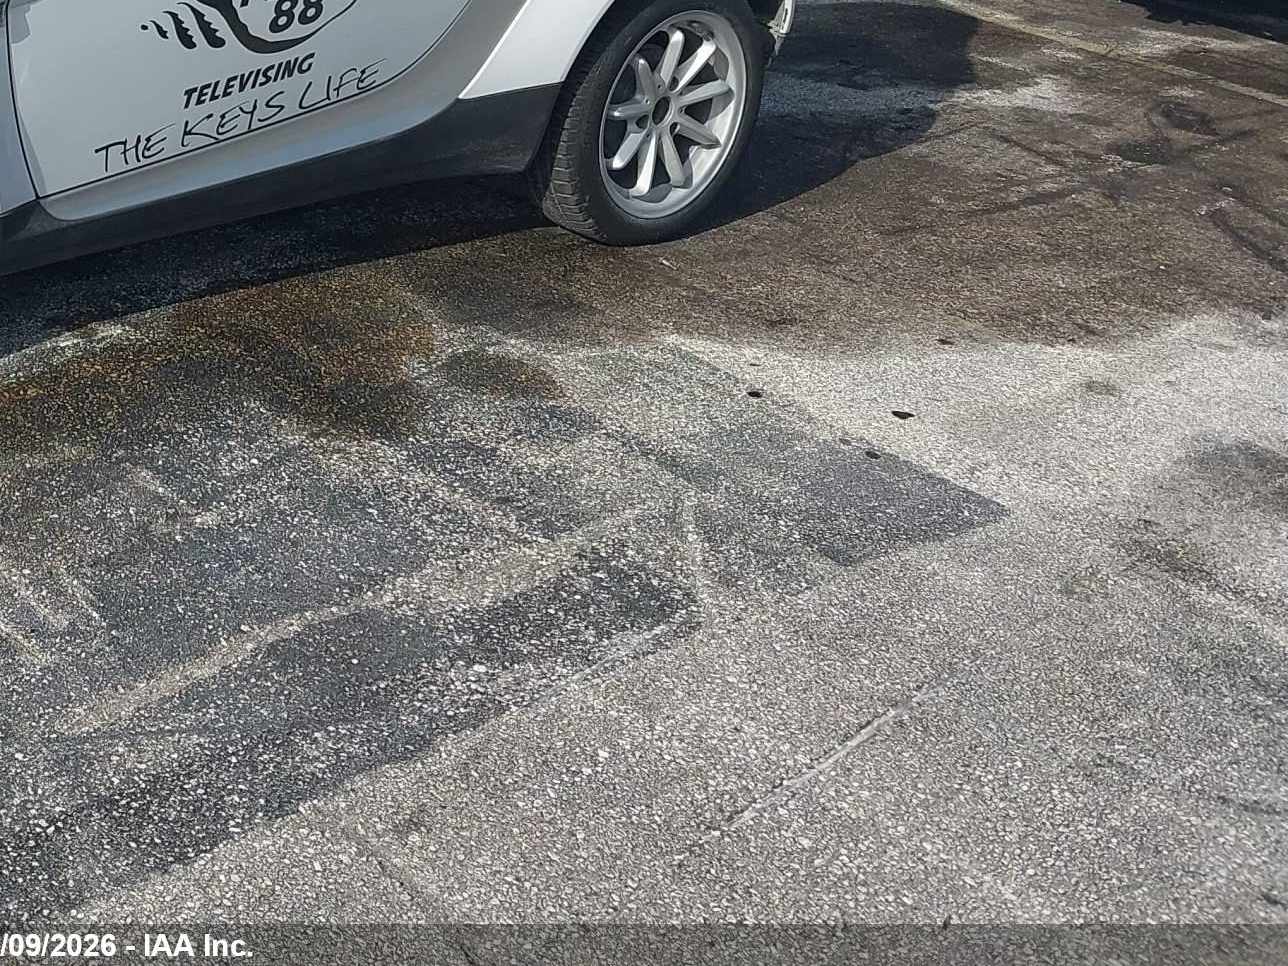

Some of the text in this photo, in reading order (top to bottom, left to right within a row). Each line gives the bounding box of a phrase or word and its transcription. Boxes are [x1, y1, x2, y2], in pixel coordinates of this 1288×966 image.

[94, 57, 388, 172] THE KEYS LIFE
[183, 52, 316, 109] TELEVISING
